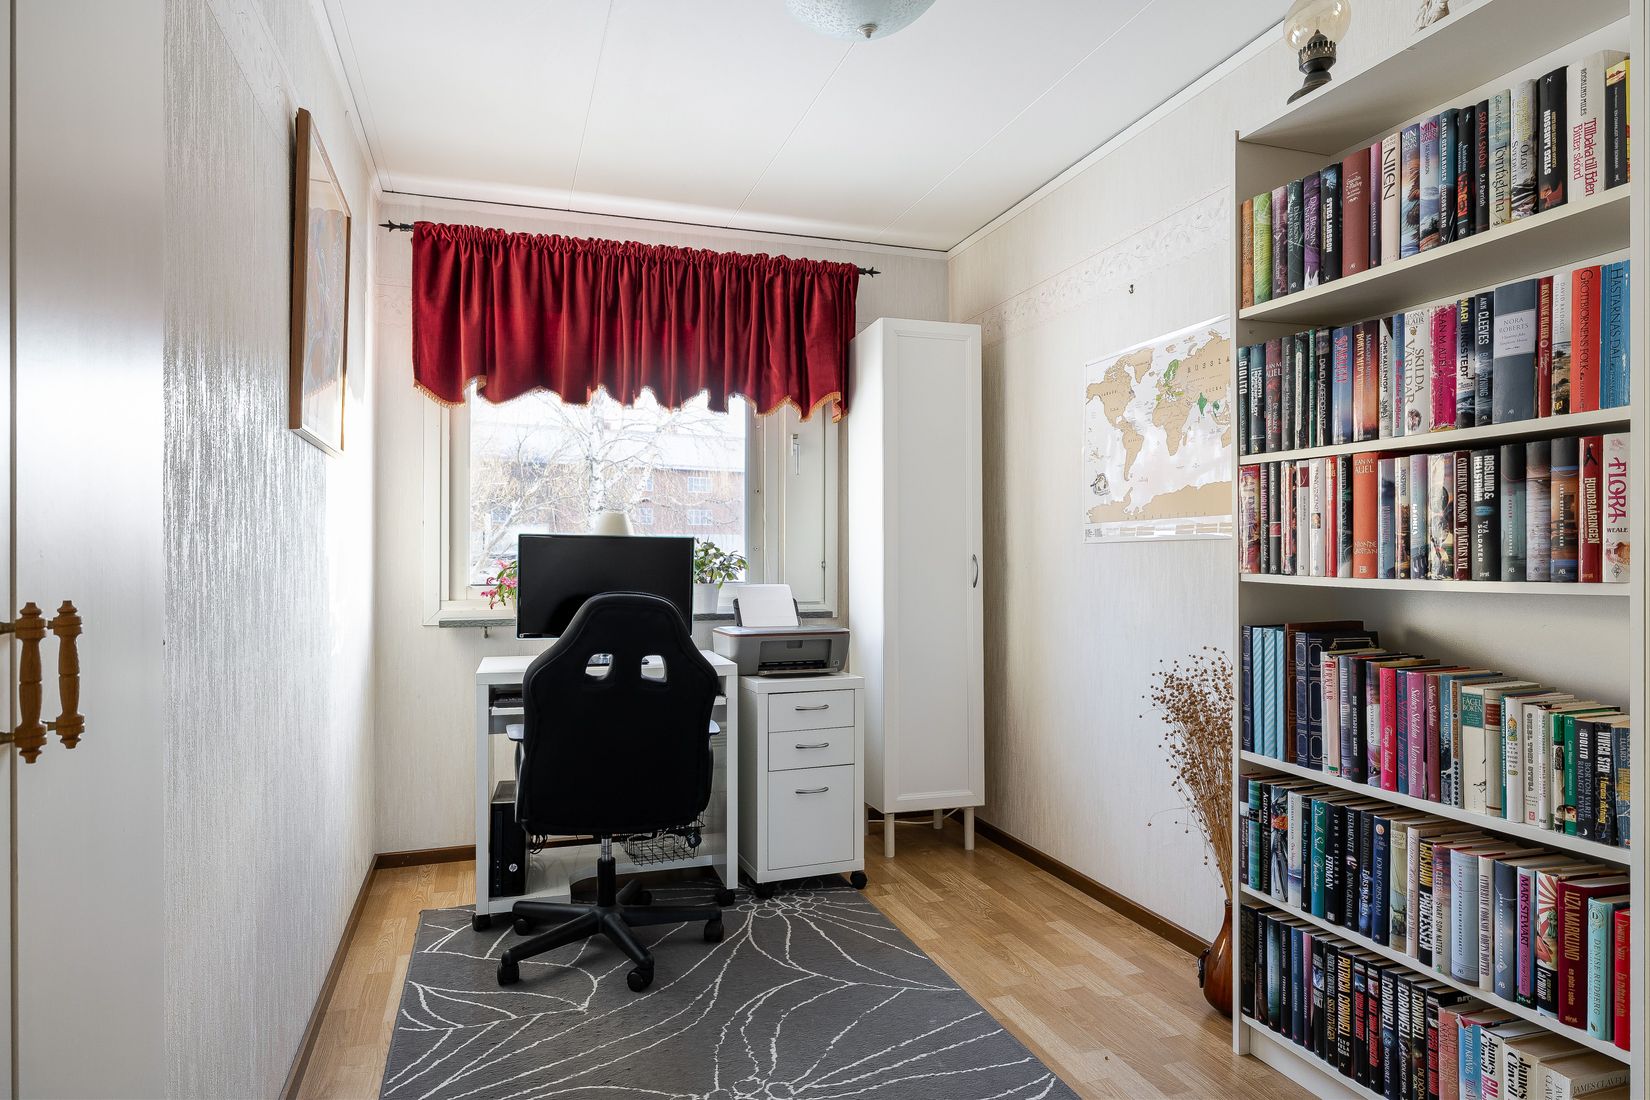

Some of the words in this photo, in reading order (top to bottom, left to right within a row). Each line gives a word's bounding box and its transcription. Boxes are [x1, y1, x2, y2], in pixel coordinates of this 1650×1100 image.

[1580, 68, 1588, 98] ROSALIND
[1402, 128, 1416, 140] MIN
[1420, 120, 1437, 131] MIN
[1479, 112, 1487, 134] SPÅR
[1544, 110, 1552, 148] LARSSON
[1572, 124, 1584, 150] Bitter
[1584, 118, 1598, 157] Tillbaka
[1478, 142, 1487, 168] SNÖN
[1511, 140, 1519, 186] SVEDELID
[1520, 144, 1530, 171] OLOV
[1544, 151, 1552, 176] STIEG
[1573, 152, 1584, 181] skörd
[1492, 142, 1508, 214] Törnfåglarna
[1584, 170, 1598, 198] Eden
[1310, 197, 1318, 215] DAN
[1309, 217, 1318, 246] BROWN
[1460, 300, 1468, 323] MARI
[1580, 270, 1594, 346] GROTTBJÖRNENS
[1610, 268, 1624, 336] HÄSTARNAS
[1439, 308, 1448, 333] JEAN
[1478, 311, 1489, 345] CLEEVES
[1498, 324, 1529, 334] ROBERTS
[1504, 317, 1524, 326] NORA
[1540, 317, 1550, 340] PILCHER
[1356, 331, 1364, 358] BORTA
[1439, 335, 1448, 345] M
[1460, 324, 1468, 378] JUNGSTEDT
[1610, 340, 1621, 361] DAL
[1187, 356, 1230, 374] RUSSIA
[1404, 338, 1416, 406] VÄRLDAR
[1414, 348, 1425, 394] SKILDA
[1439, 348, 1448, 368] AUEL
[1580, 348, 1589, 370] FOLK
[1238, 361, 1248, 395] GIOLITO
[1354, 464, 1374, 474] AUEL
[1456, 458, 1468, 492] CATHERINE
[1474, 456, 1484, 502] HELLSTRÖM
[1484, 454, 1494, 491] ROSLUND
[1608, 456, 1627, 524] FLORA
[1457, 494, 1468, 522] COOKSON
[1584, 478, 1600, 544] HUNDRAÅRINGEN
[1410, 688, 1420, 712] Sidney
[1428, 683, 1436, 704] Sidney
[1462, 697, 1482, 706] FÅGEL
[1462, 704, 1483, 713] BOKEN
[1410, 712, 1420, 739] Sheldon
[1580, 732, 1588, 760] GIOLITO
[1597, 732, 1610, 756] VIVECA
[1598, 757, 1610, 774] STEN
[1600, 780, 1610, 800] farans
[1314, 804, 1324, 833] Danielle
[1598, 800, 1608, 824] riktning
[1314, 832, 1324, 854] Steel
[1326, 854, 1334, 890] FIRMAN
[1420, 842, 1432, 888] GRISHAM
[1361, 868, 1371, 918] FÖRSVARAREN
[1375, 880, 1383, 917] GRISHAM
[1520, 874, 1529, 906] MARY
[1564, 891, 1580, 911] LIZA
[1420, 890, 1432, 952] PROCESSEN
[1520, 904, 1529, 948] STEWART
[1564, 911, 1580, 962] MARKLUND
[1480, 952, 1490, 977] DOTTER
[1594, 938, 1602, 972] DENISE
[1338, 956, 1350, 994] PATRICIA
[1537, 968, 1552, 1000] Carmine
[1382, 980, 1394, 1031] CORNWELL
[1594, 972, 1602, 1016] RUDBERG
[1338, 993, 1350, 1037] CORNWELL
[1398, 983, 1410, 1040] CORNWELL
[1412, 992, 1424, 1040] CORNWELL
[1488, 1038, 1499, 1076] James
[1508, 1052, 1518, 1098] Clavell
[1518, 1057, 1532, 1100] James
[1572, 1082, 1596, 1094] JAMES
[1596, 1075, 1628, 1088] CLAVELL
